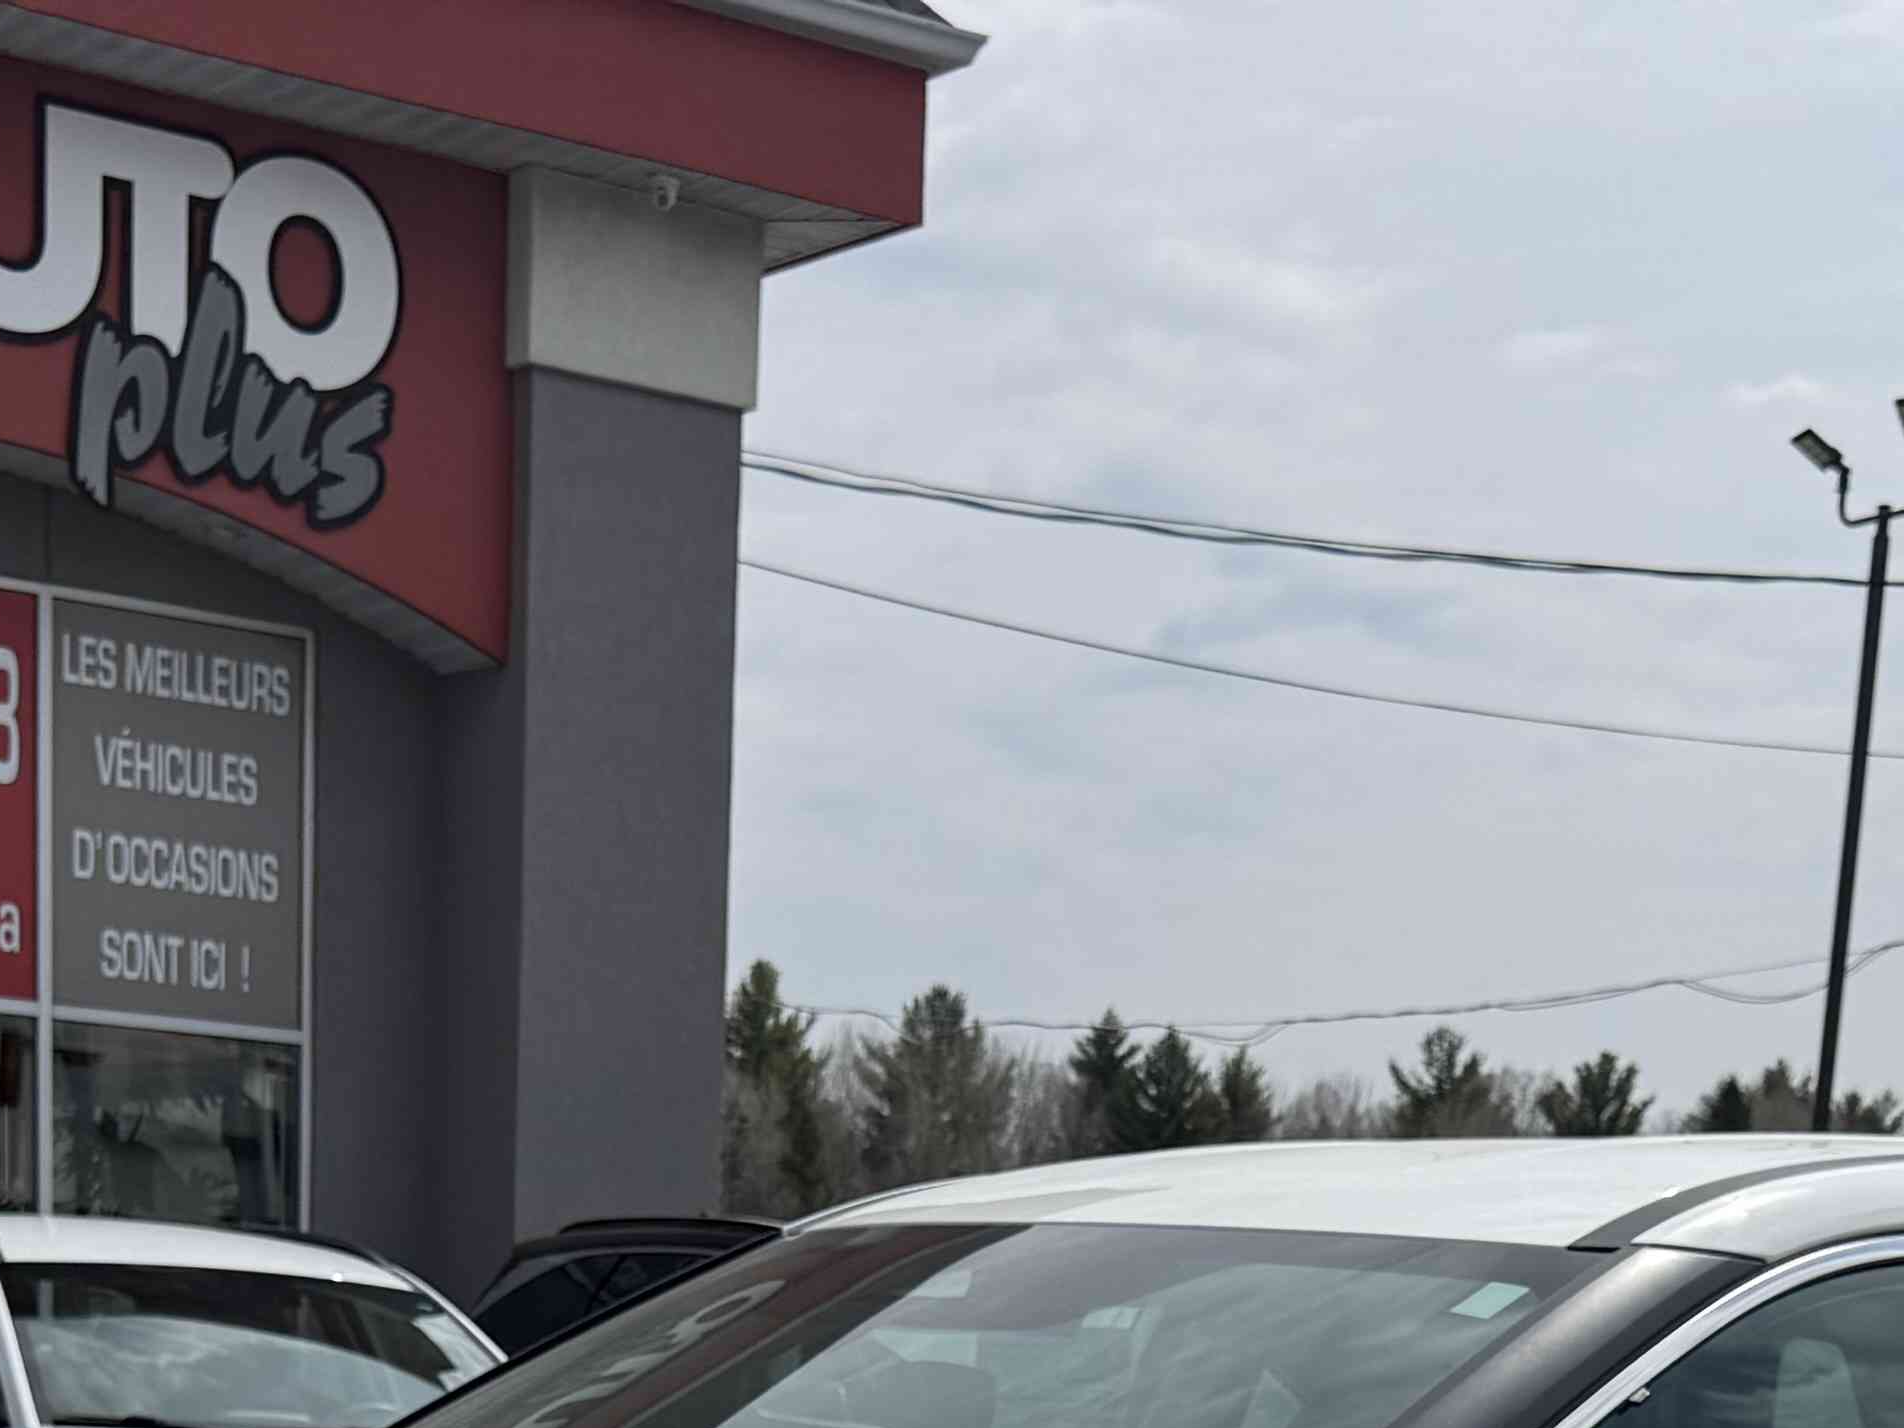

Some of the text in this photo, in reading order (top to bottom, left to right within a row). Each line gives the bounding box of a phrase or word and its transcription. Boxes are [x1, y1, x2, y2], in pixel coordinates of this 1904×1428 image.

[72, 262, 394, 524] plus
[62, 633, 292, 716] LES MEILLEURS
[94, 726, 258, 806] VÉHICULES
[100, 928, 251, 993] SONT ICI !
